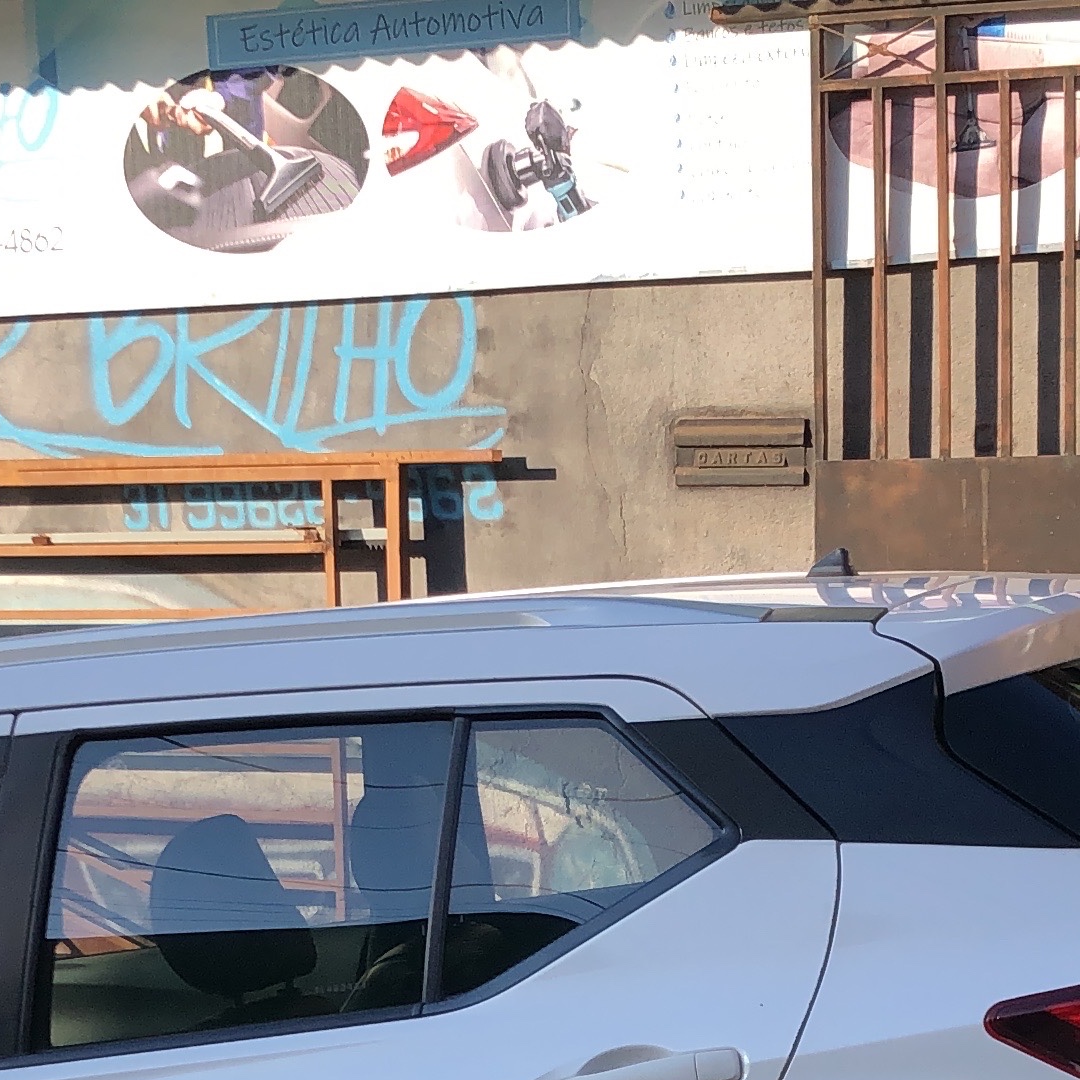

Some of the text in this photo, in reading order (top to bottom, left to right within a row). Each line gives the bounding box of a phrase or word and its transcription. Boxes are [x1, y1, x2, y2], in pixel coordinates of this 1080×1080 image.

[240, 2, 544, 52] Estética Automotiva
[90, 296, 504, 452] BRILHO
[698, 451, 784, 465] CARTAS
